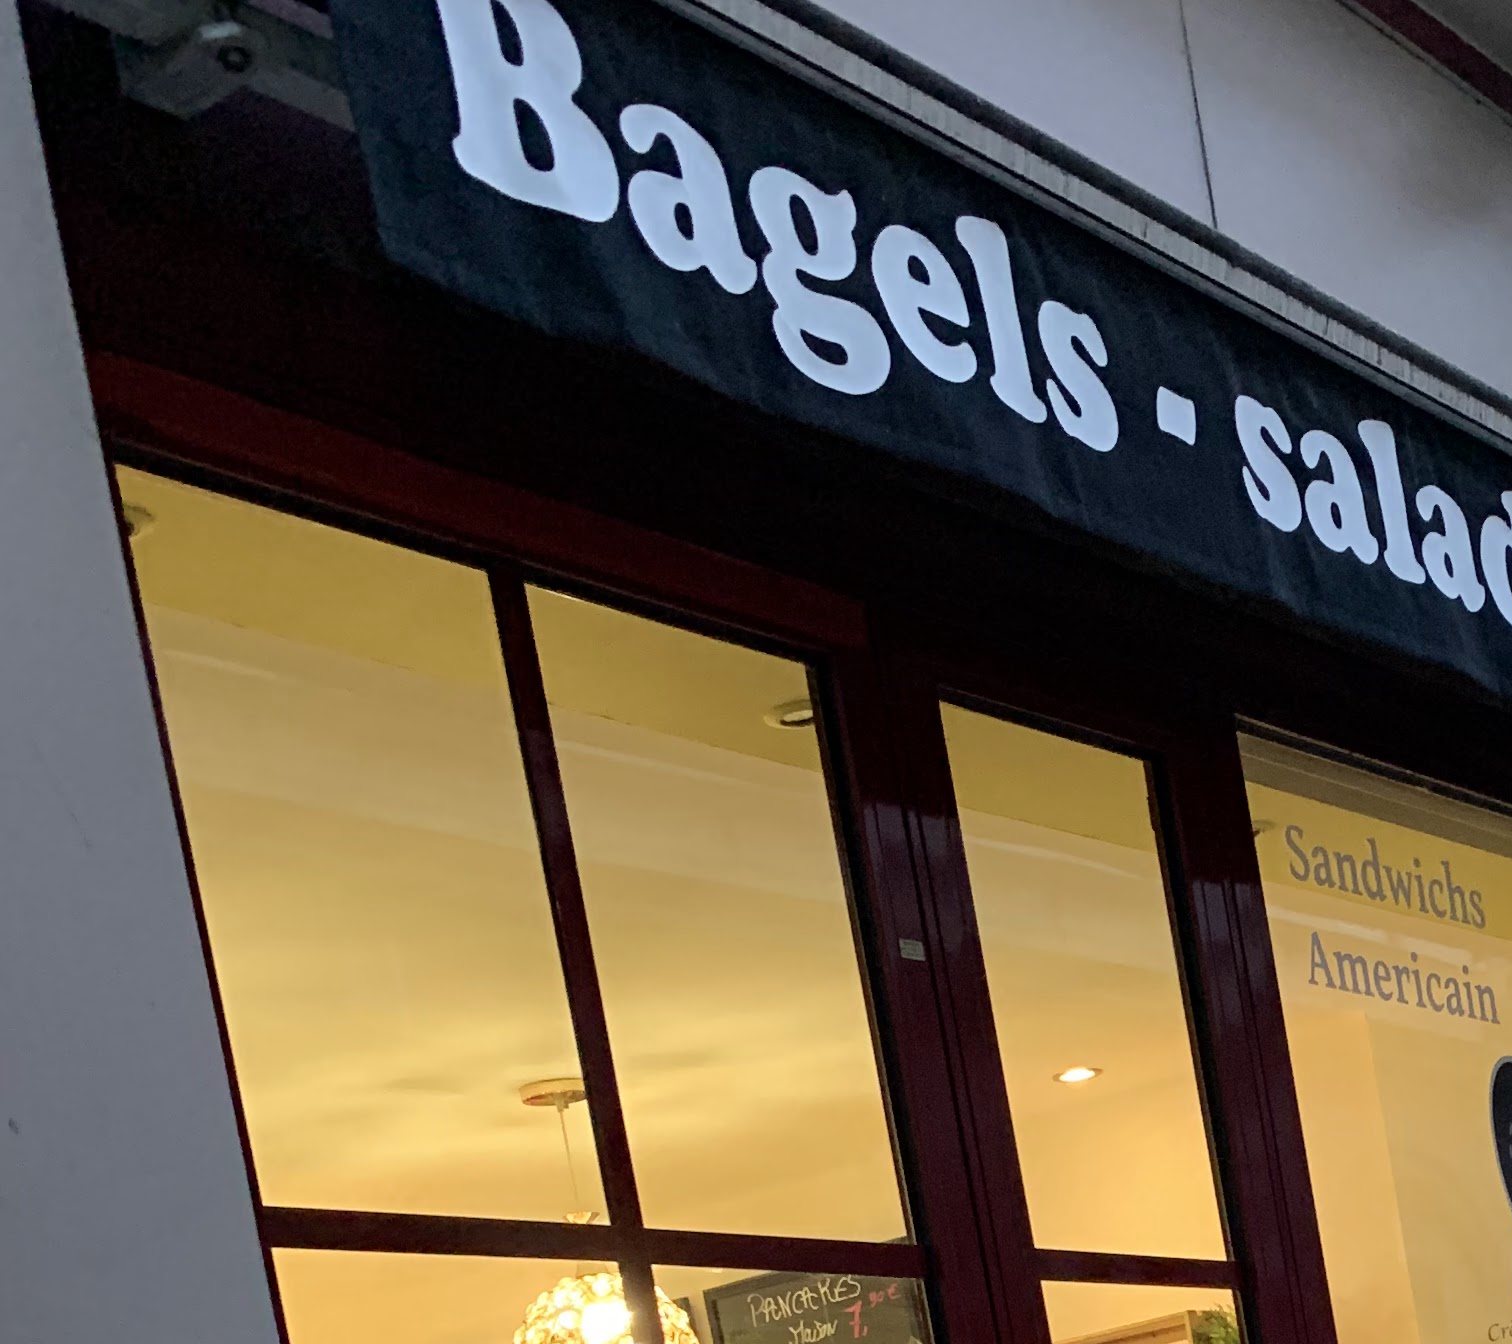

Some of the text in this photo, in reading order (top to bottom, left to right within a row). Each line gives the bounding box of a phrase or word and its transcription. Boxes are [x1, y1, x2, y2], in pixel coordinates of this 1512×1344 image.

[437, 0, 1119, 453] Bagels
[1285, 824, 1486, 929] Sandwichs
[1308, 931, 1501, 1024] Americain
